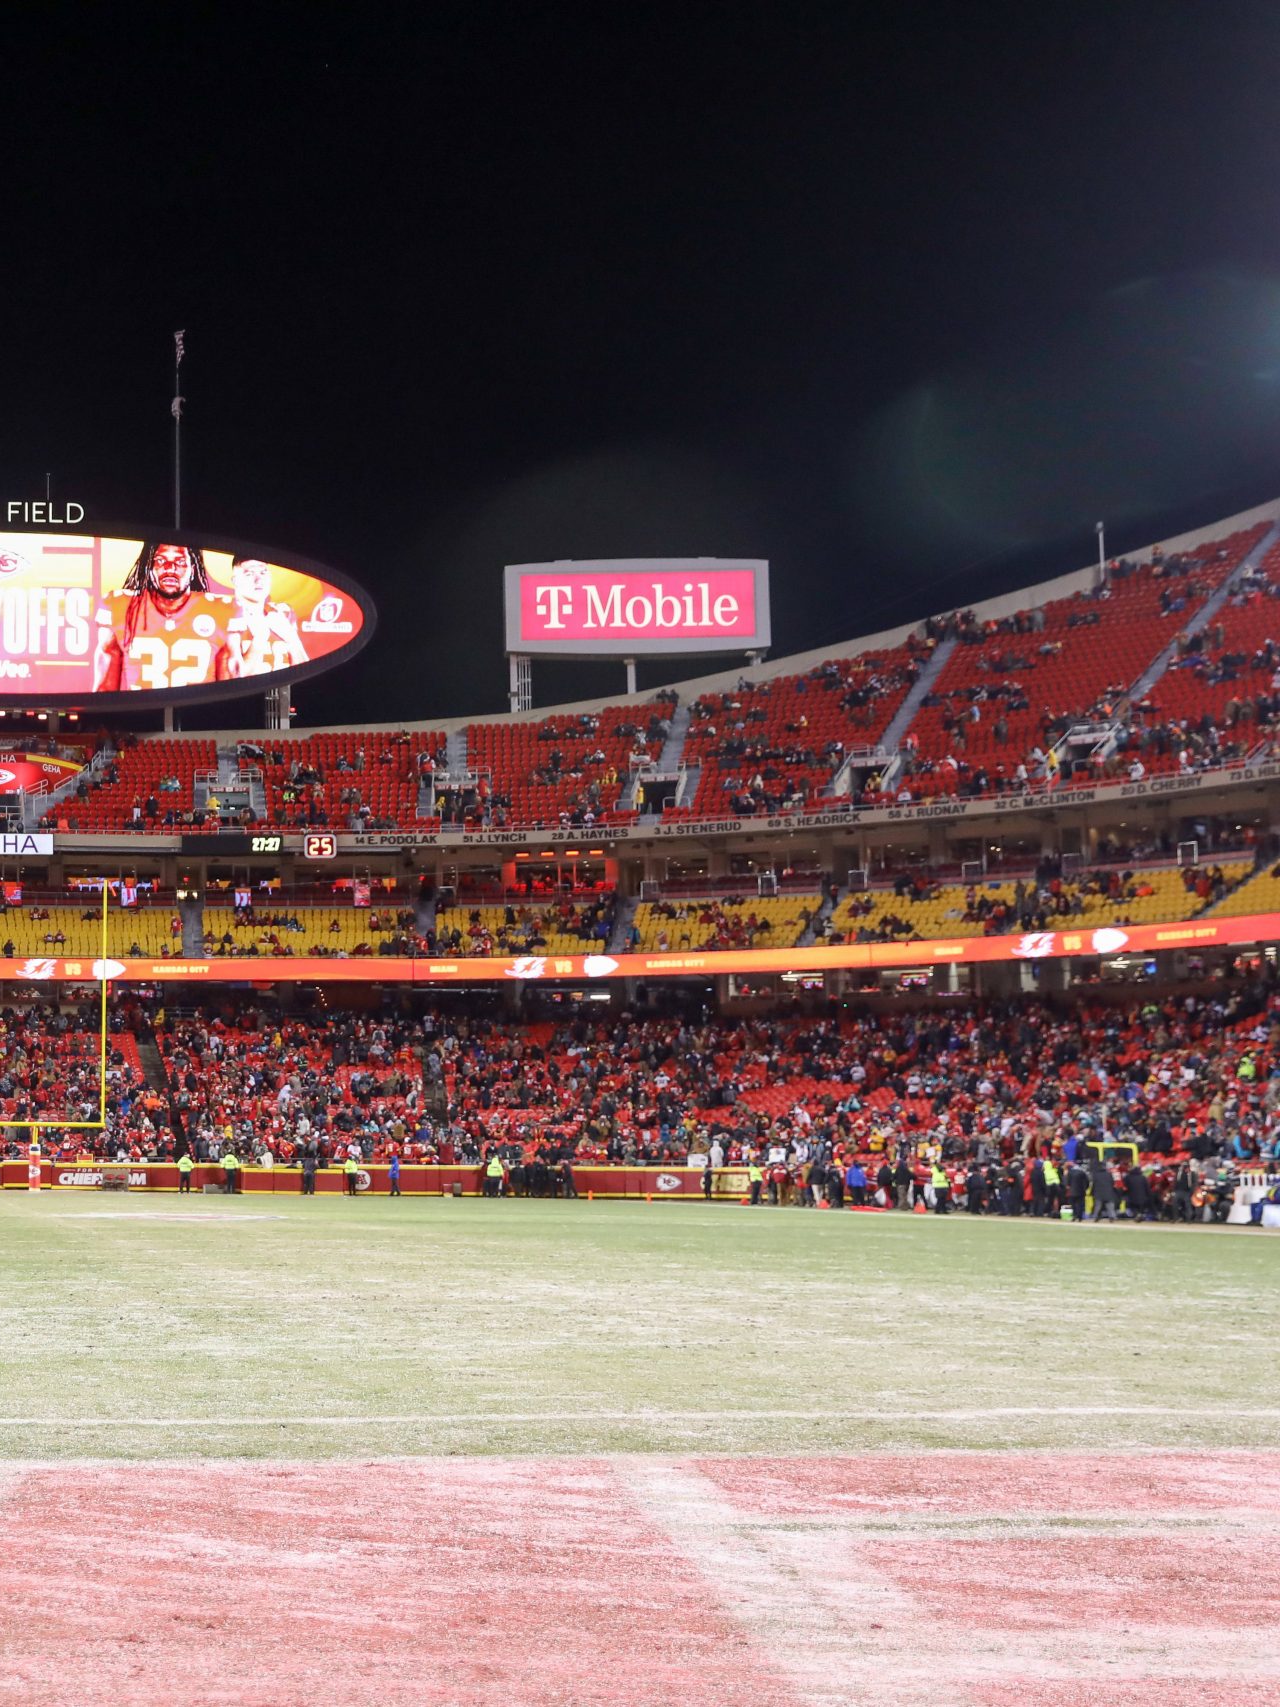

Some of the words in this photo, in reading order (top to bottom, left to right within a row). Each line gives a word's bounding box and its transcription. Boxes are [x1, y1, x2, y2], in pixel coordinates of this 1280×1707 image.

[7, 501, 85, 524] FIELD
[582, 583, 739, 628] Mobile
[129, 637, 213, 691] 32
[42, 763, 62, 775] GEHA
[1244, 768, 1258, 780] D.
[1258, 764, 1280, 778] HIL
[1136, 783, 1149, 795] D.
[1150, 775, 1204, 794] CHERRY
[904, 808, 916, 819] J.
[916, 803, 969, 818] RUDNAY
[767, 818, 782, 829] 69
[783, 817, 795, 828] S.
[796, 813, 863, 828] HEADRICK
[565, 830, 579, 841] A.
[580, 828, 629, 841] HAYNES
[654, 826, 662, 836] 3
[663, 826, 675, 836] J.
[676, 822, 742, 836] STENERUD
[251, 837, 281, 852] 27:27
[355, 836, 366, 845] 14
[367, 836, 379, 846] E.
[380, 835, 437, 845] PODOLAK
[463, 835, 474, 844] 51
[475, 834, 486, 844] J.
[487, 833, 528, 844] LYNCH
[308, 838, 332, 856] 25
[64, 963, 81, 976] VS
[152, 966, 188, 974] KANSAS
[189, 966, 209, 974] CITY
[554, 960, 572, 973] VS
